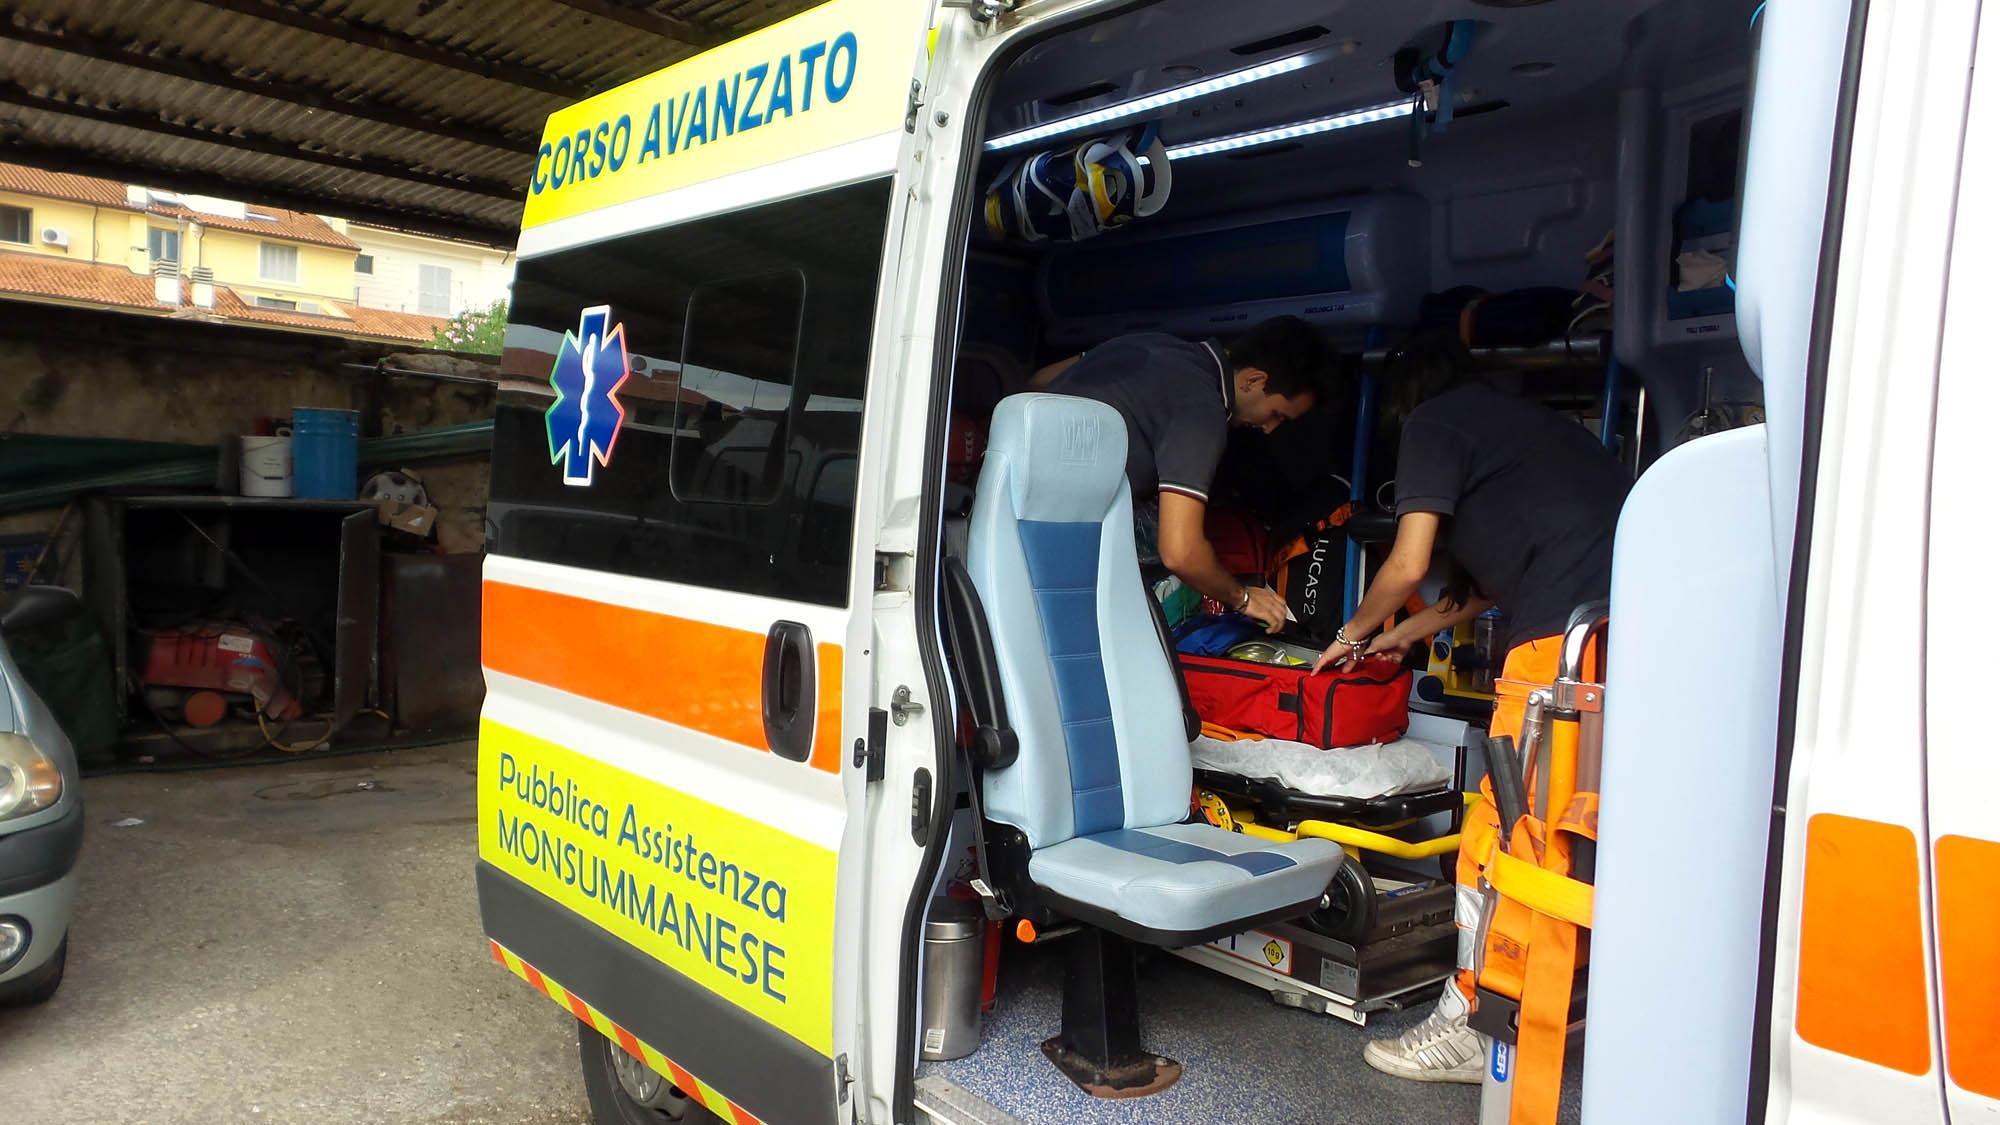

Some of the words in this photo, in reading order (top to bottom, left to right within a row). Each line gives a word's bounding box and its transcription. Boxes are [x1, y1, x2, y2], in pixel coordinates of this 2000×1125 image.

[531, 114, 632, 195] CORSO
[638, 31, 858, 164] AVANZATO
[498, 809, 787, 1004] MONSUMMANESE
[499, 752, 608, 840] Pubblica
[617, 803, 788, 923] Assistenza
[1496, 1040, 1508, 1075] CER
